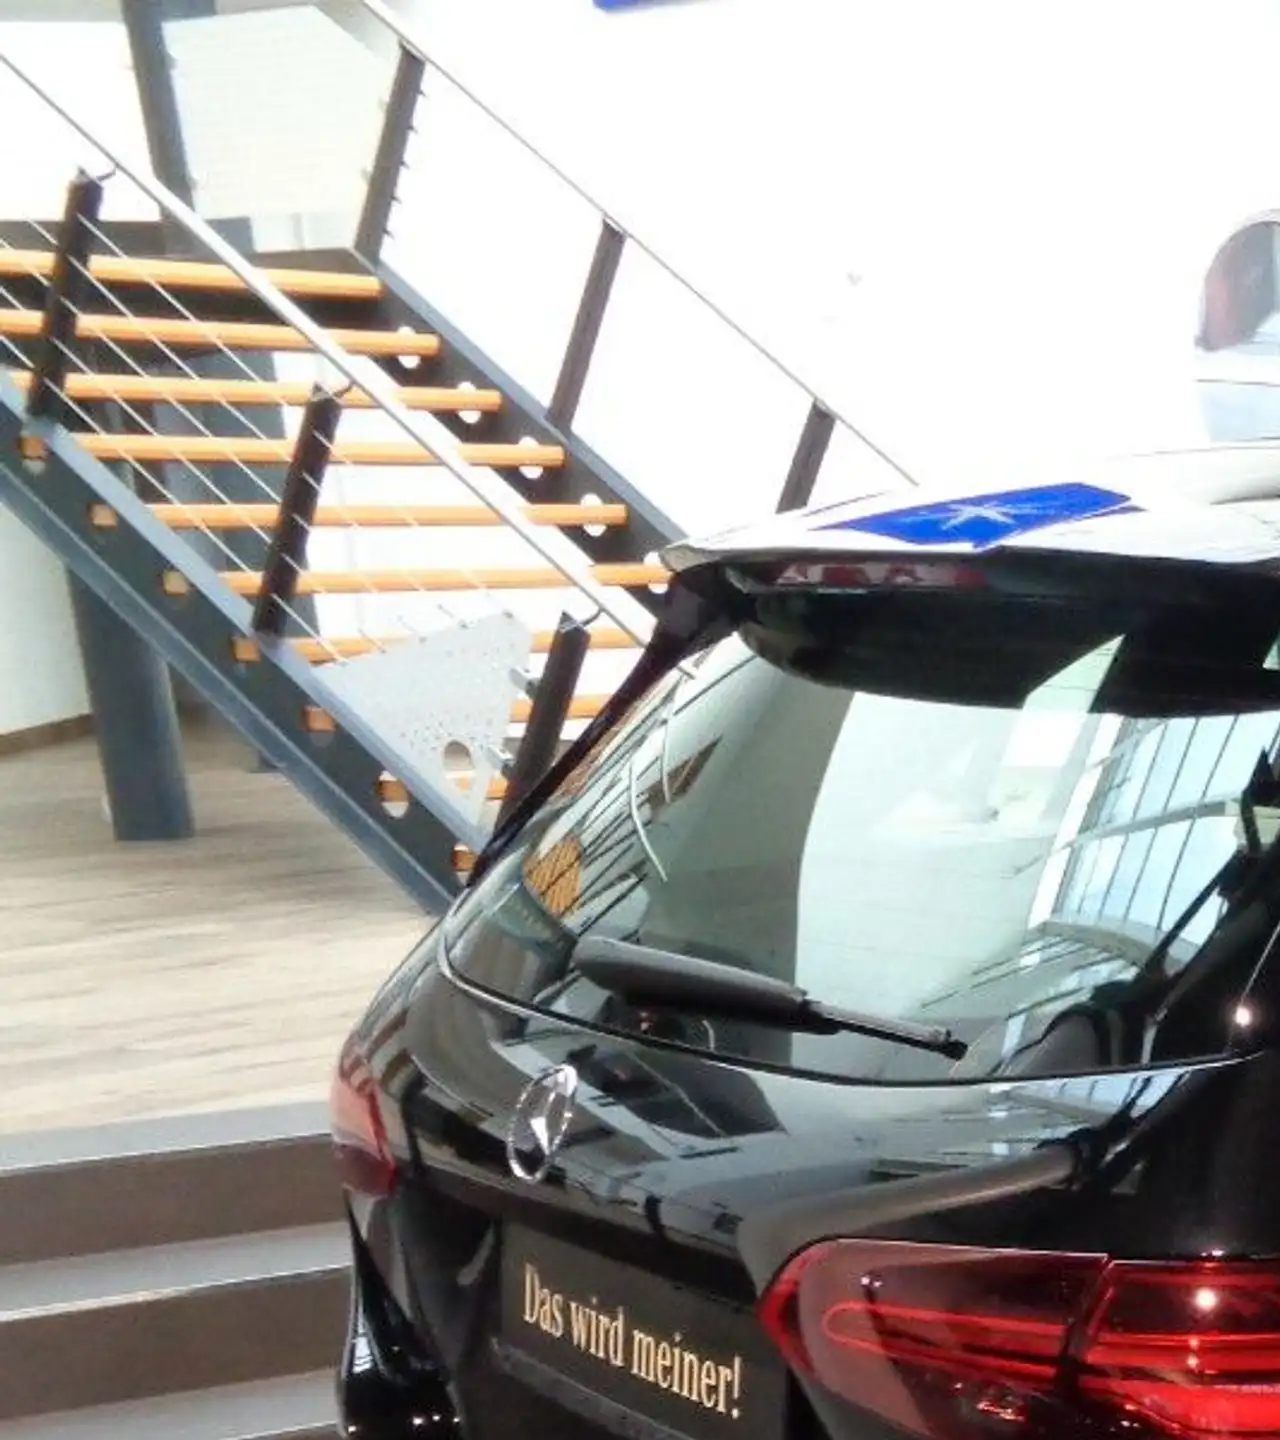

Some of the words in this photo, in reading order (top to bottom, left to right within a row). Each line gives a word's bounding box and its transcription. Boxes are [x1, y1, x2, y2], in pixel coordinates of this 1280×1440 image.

[524, 1263, 563, 1337] Das
[569, 1297, 625, 1367] wird
[631, 1329, 743, 1419] meiner!
